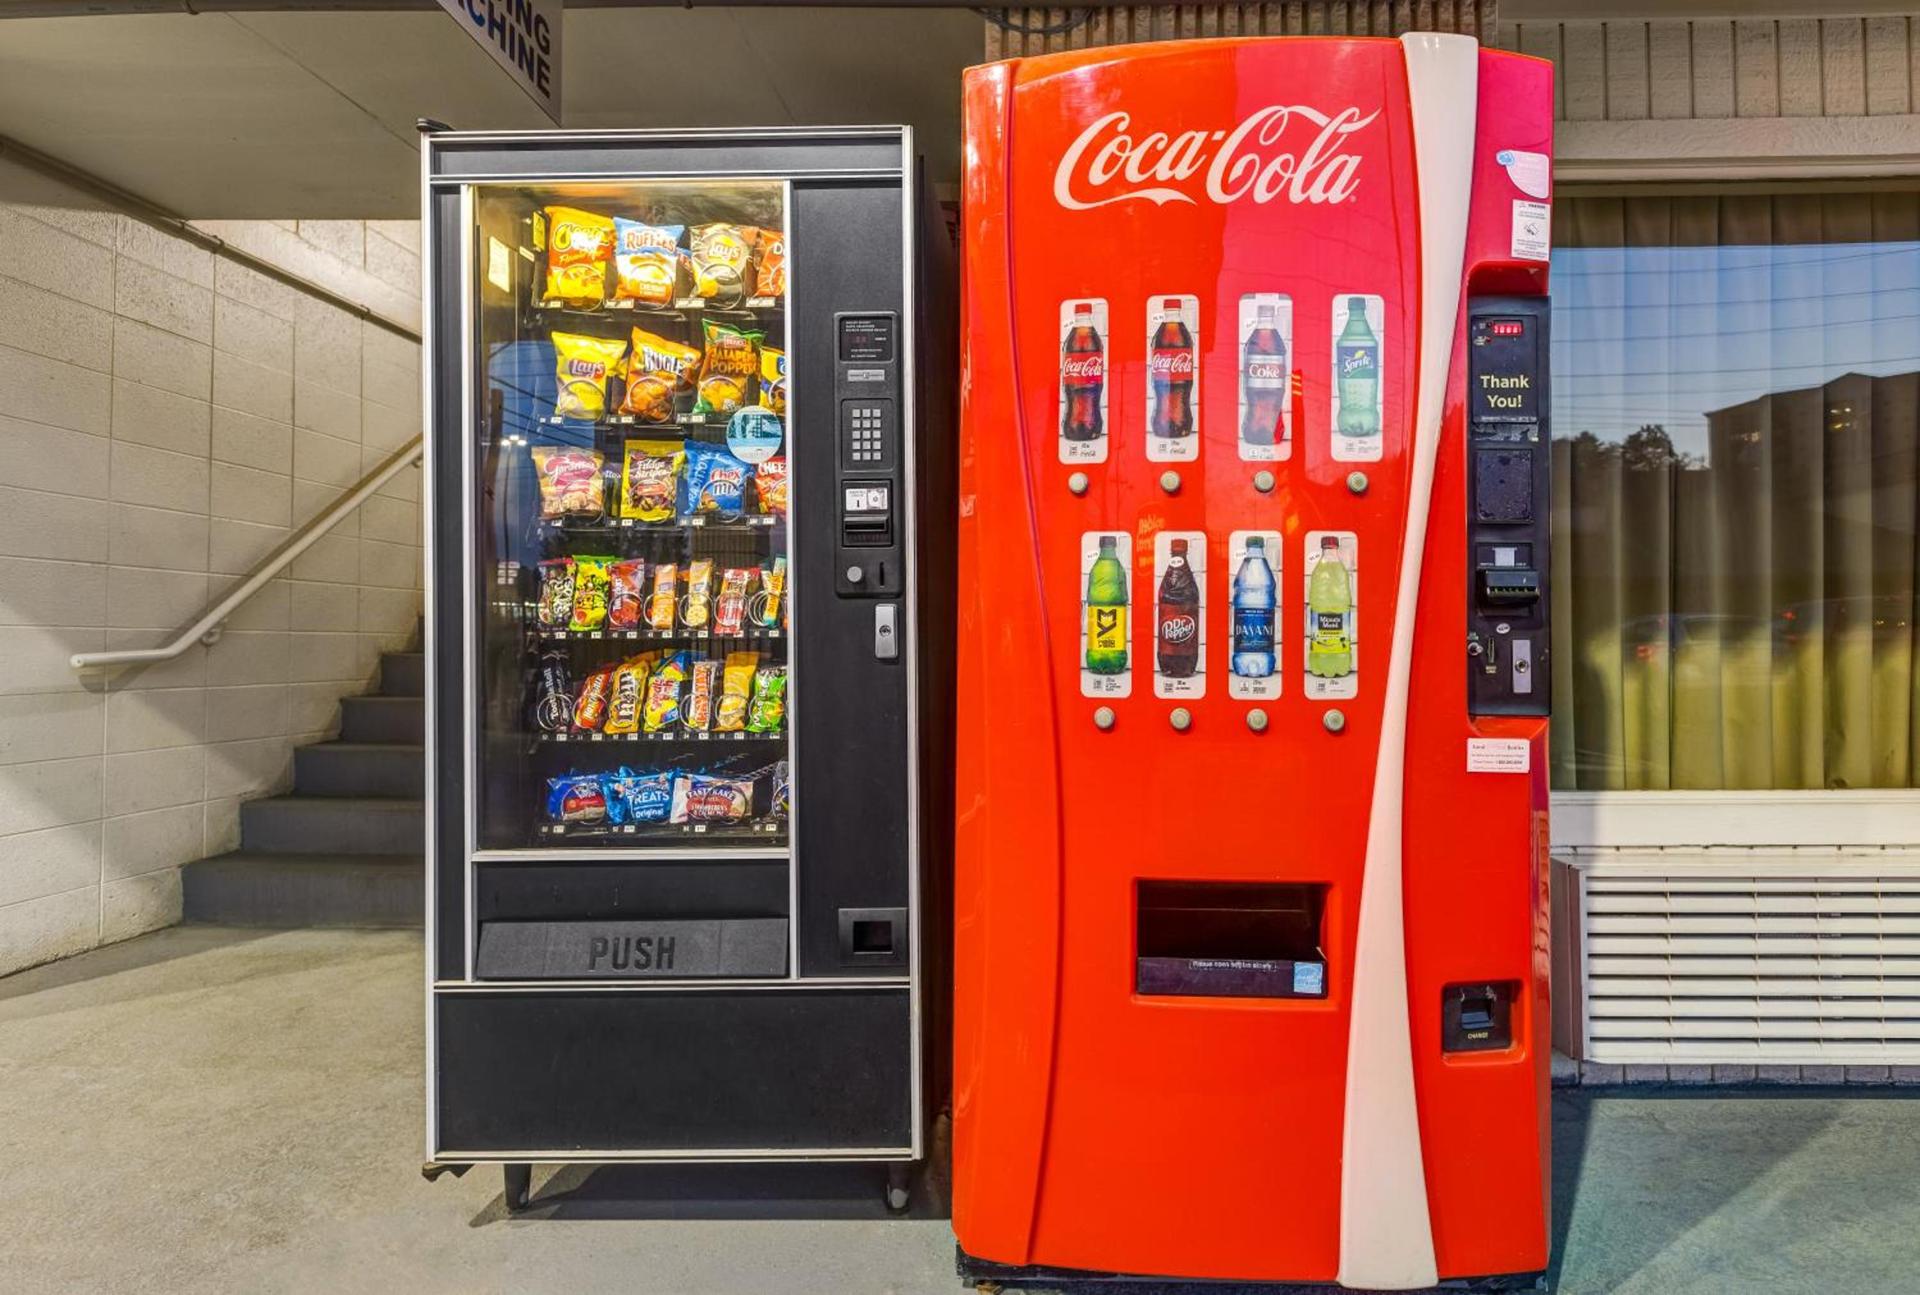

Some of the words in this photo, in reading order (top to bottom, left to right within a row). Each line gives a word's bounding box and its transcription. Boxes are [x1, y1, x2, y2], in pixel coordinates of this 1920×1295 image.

[457, 0, 550, 98] CHINE
[1054, 105, 1382, 210] Coca-Cola
[1064, 356, 1102, 377] Coca-Cola
[1152, 353, 1192, 373] Coca-Cola
[1249, 364, 1280, 378] Coke
[1344, 354, 1372, 373] Sprite
[1480, 374, 1530, 389] Thank
[1487, 395, 1523, 408] You!
[1163, 621, 1193, 640] Pepper
[627, 790, 670, 806] TREATS
[635, 808, 664, 819] Original
[588, 936, 677, 972] PUSH
